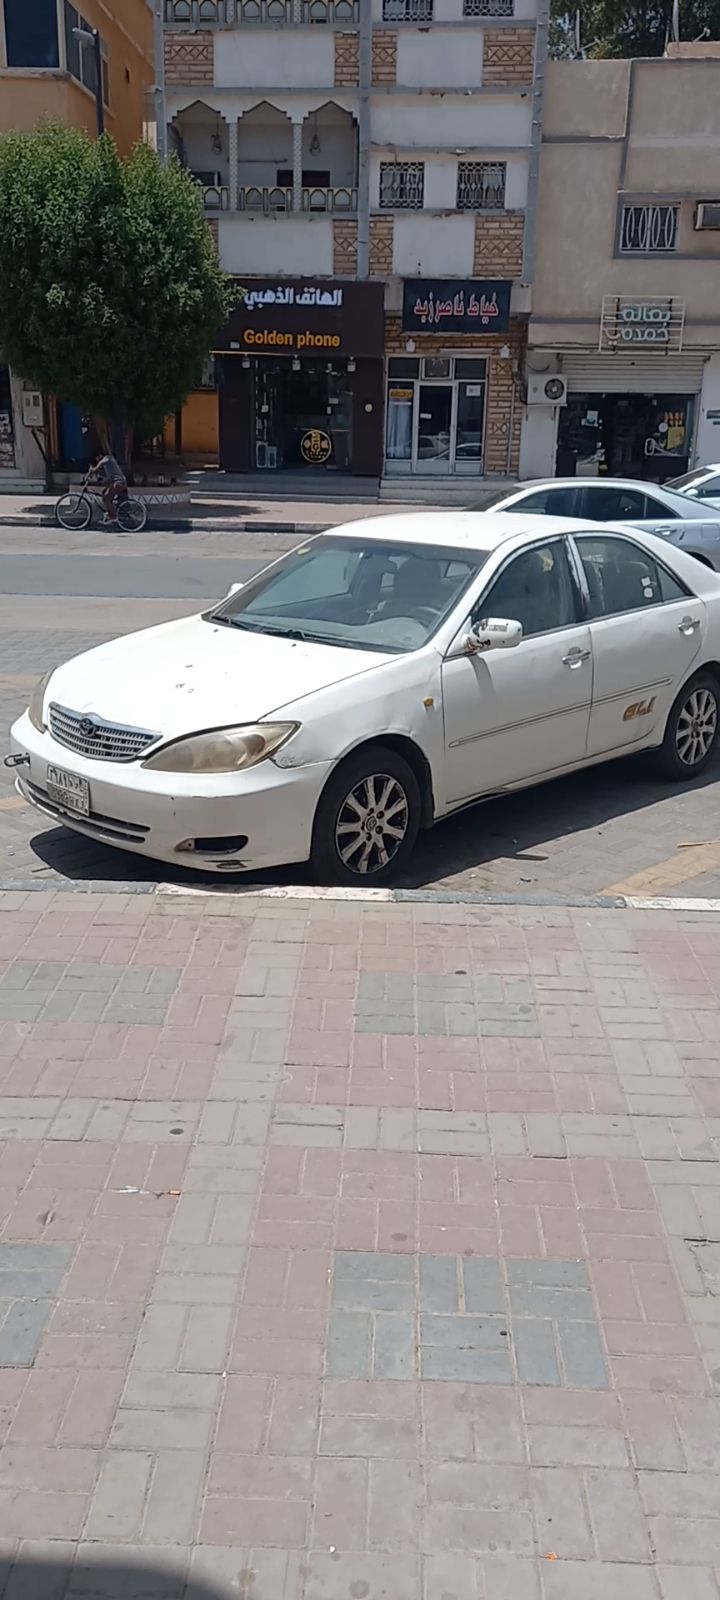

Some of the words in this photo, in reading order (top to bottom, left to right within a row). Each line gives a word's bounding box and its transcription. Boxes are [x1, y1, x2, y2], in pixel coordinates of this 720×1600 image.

[244, 286, 294, 310] الذهبي
[295, 287, 343, 306] الهاتف
[413, 291, 434, 324] زيد
[434, 290, 465, 324] ناصر
[467, 291, 499, 325] خياط
[243, 329, 293, 345] Golden
[296, 331, 341, 349] phone
